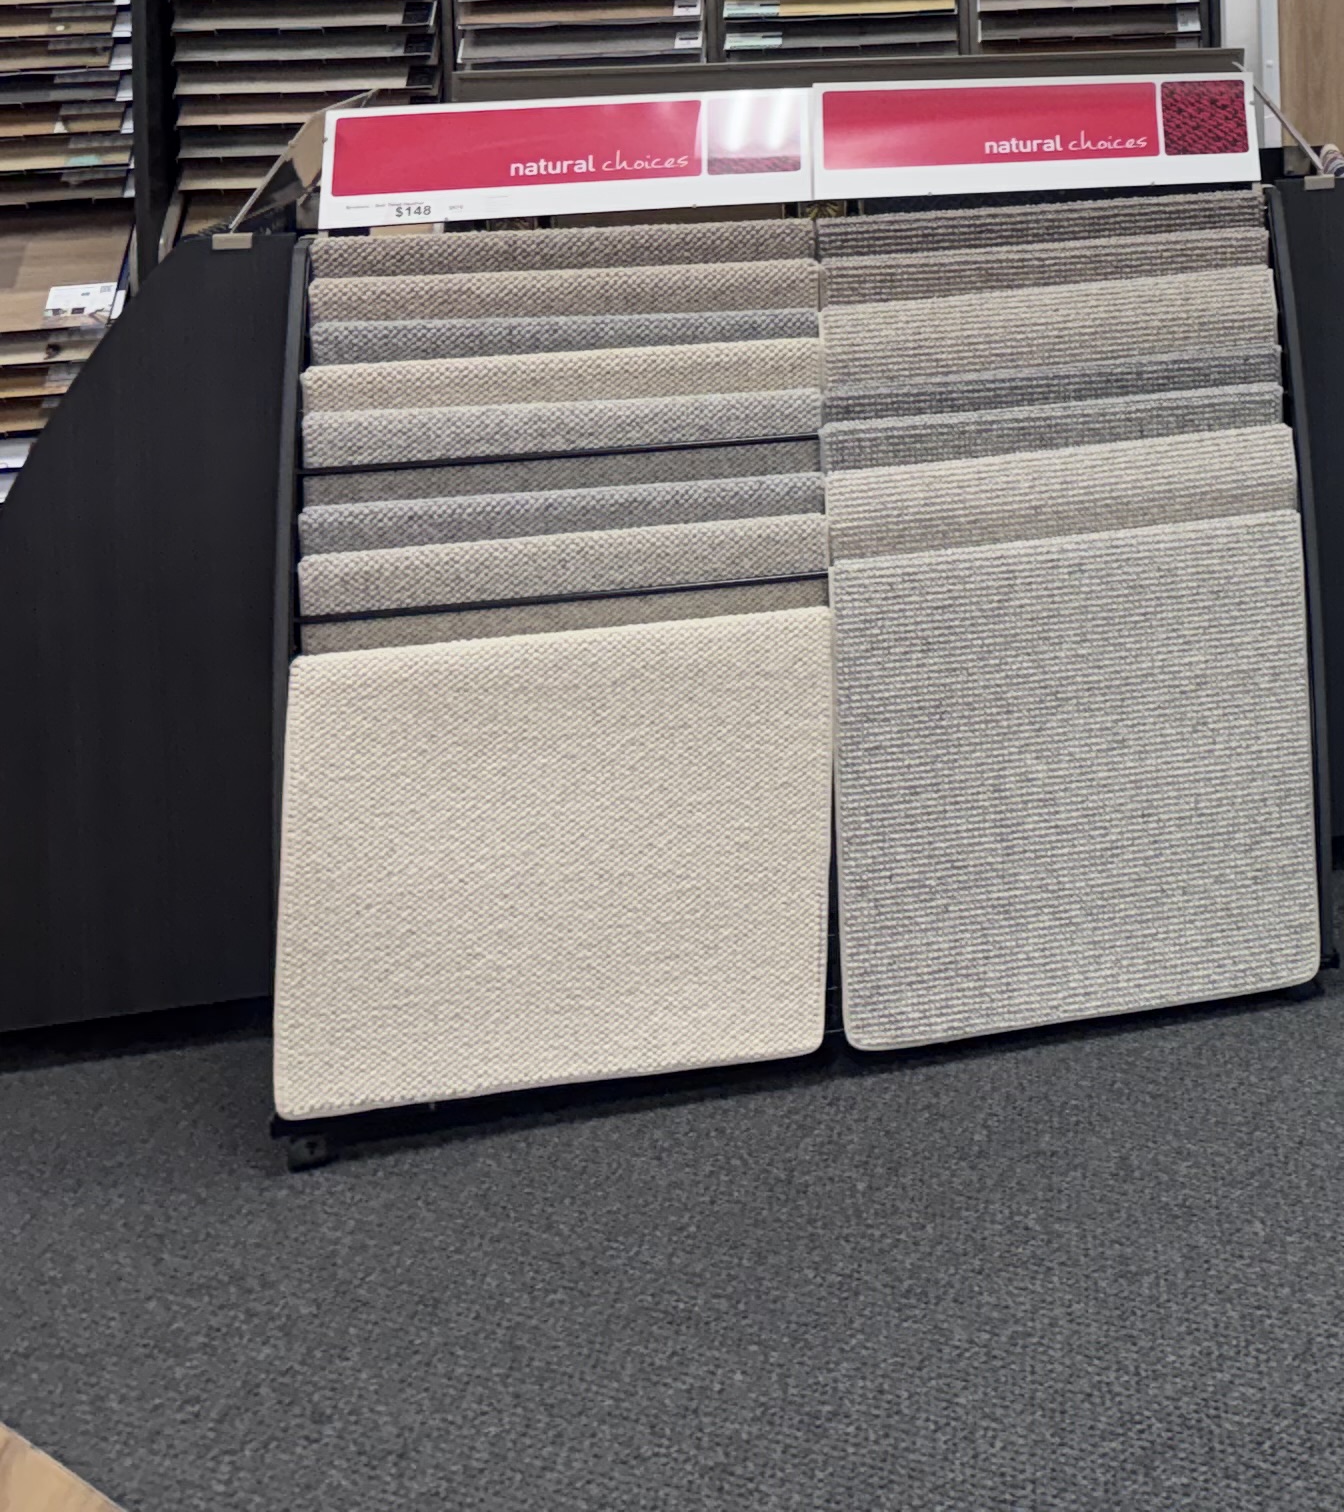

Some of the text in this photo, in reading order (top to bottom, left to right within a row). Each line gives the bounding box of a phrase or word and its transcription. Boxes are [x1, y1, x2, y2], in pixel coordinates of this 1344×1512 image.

[984, 130, 1148, 155] natural choices
[509, 149, 689, 177] natural choices
[395, 205, 432, 218] $148
